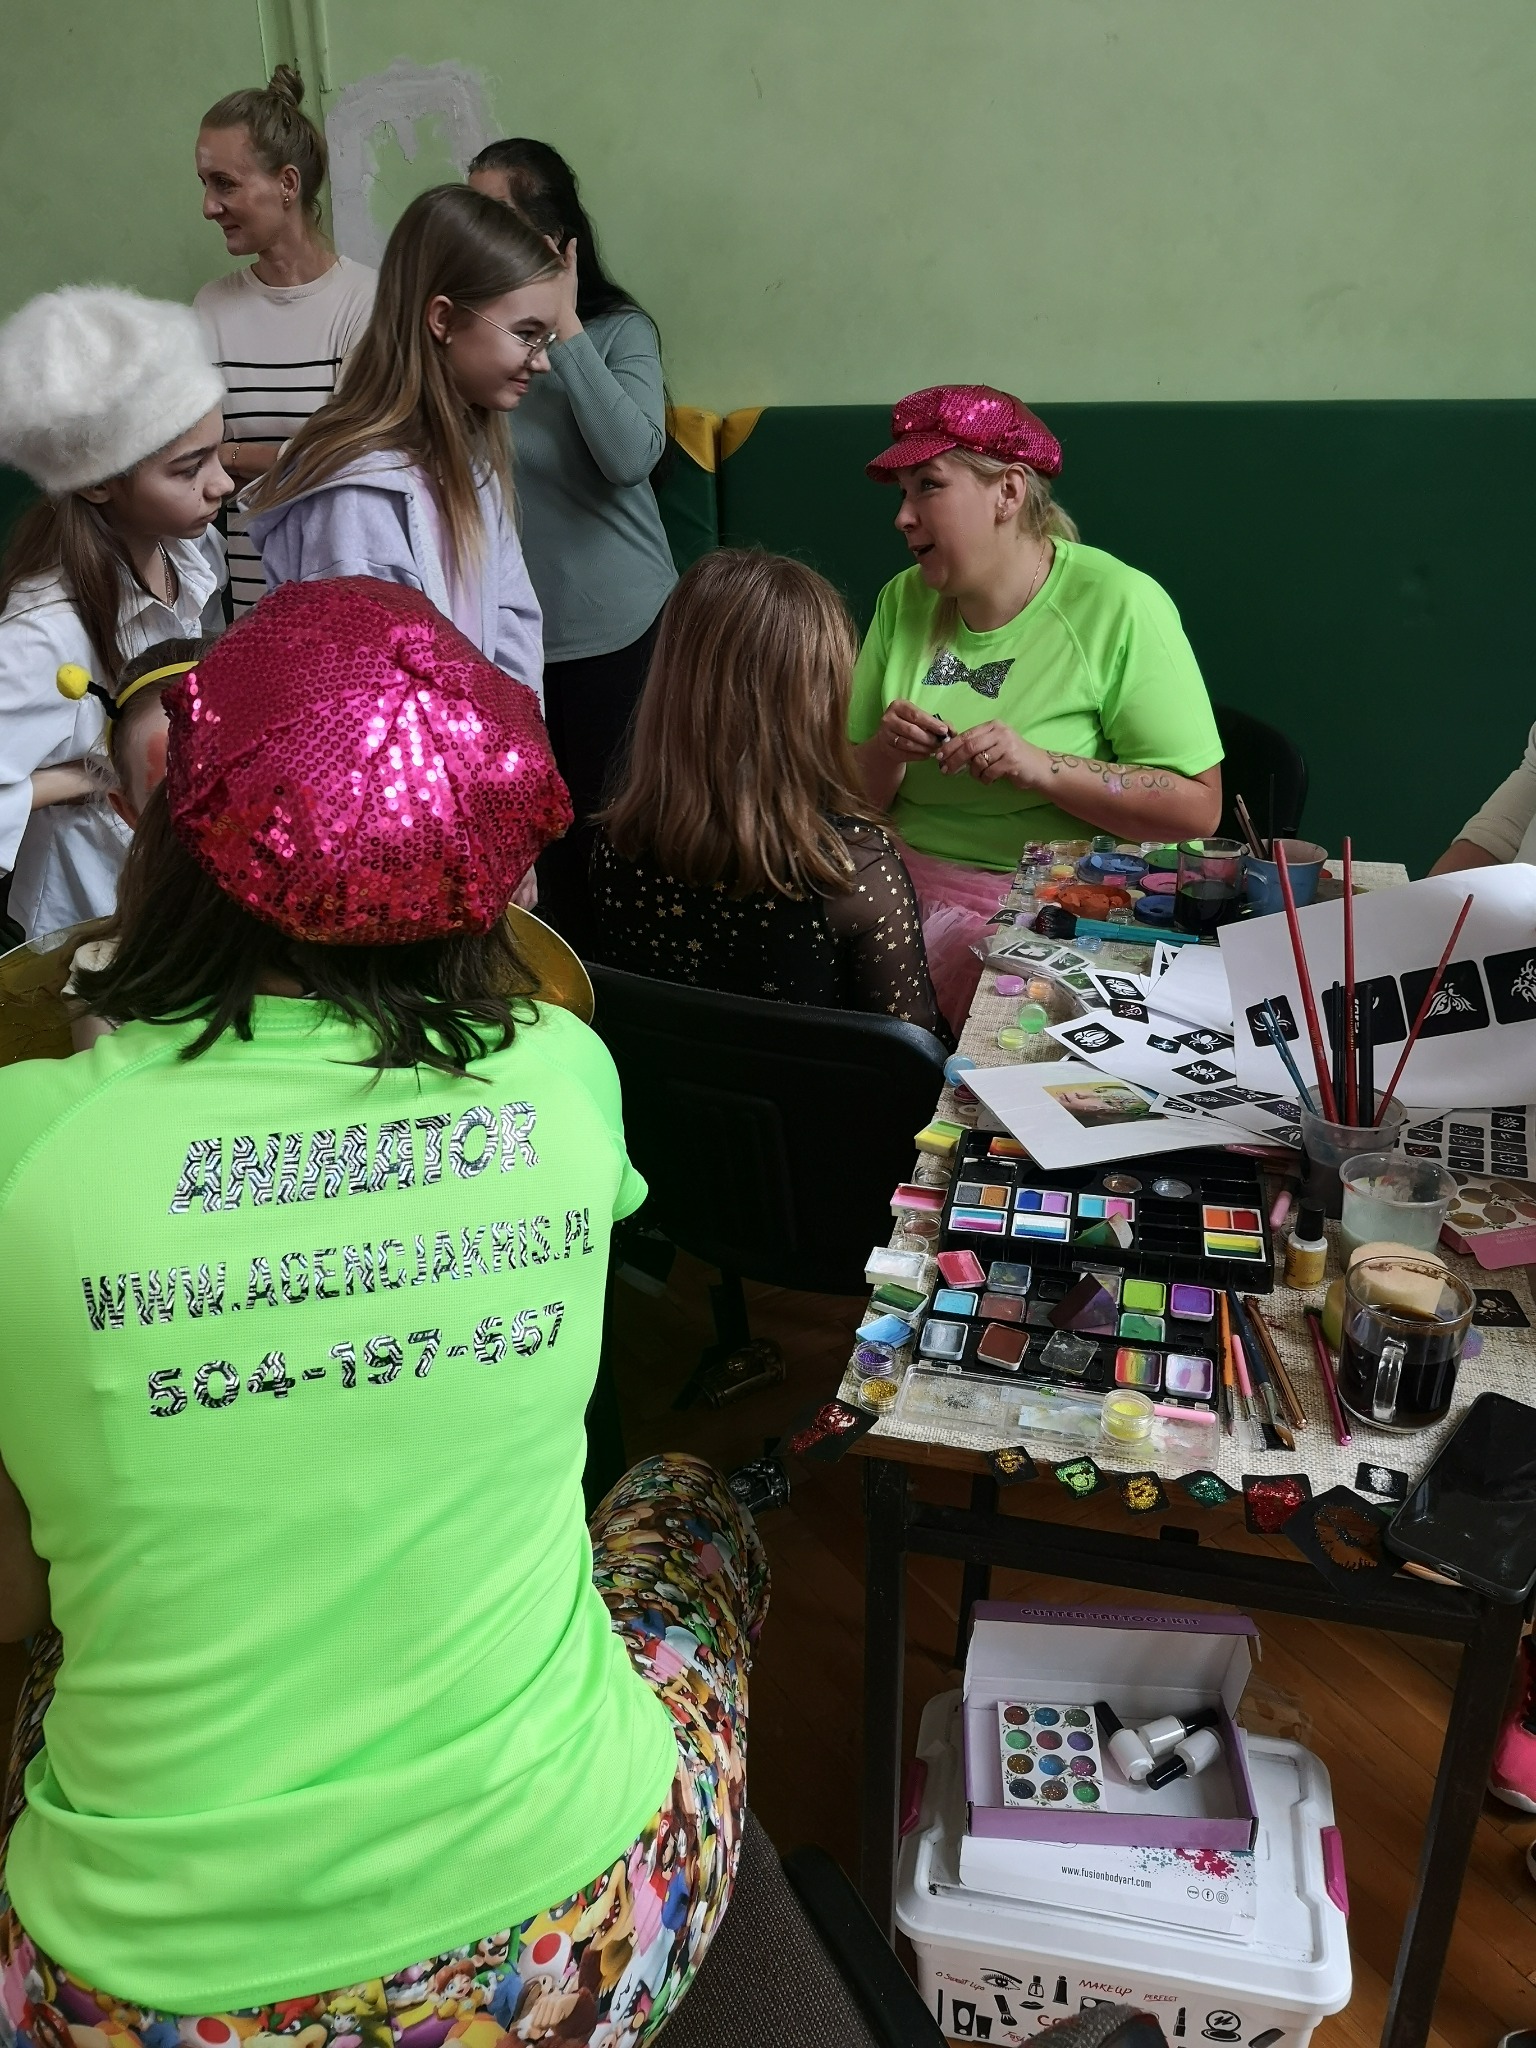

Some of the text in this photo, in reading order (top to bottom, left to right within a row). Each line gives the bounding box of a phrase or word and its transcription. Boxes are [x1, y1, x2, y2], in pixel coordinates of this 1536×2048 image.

[167, 1101, 540, 1215] ANIMATOR
[82, 1207, 596, 1331] WWW.AGENCJAKRIS.PL
[148, 1301, 565, 1418] 504-197-667
[1020, 1608, 1201, 1625] GLITTER TATTOOS KIT
[1061, 1866, 1152, 1889] www.fusionbodyart.com
[1143, 1993, 1179, 2002] PERFECT
